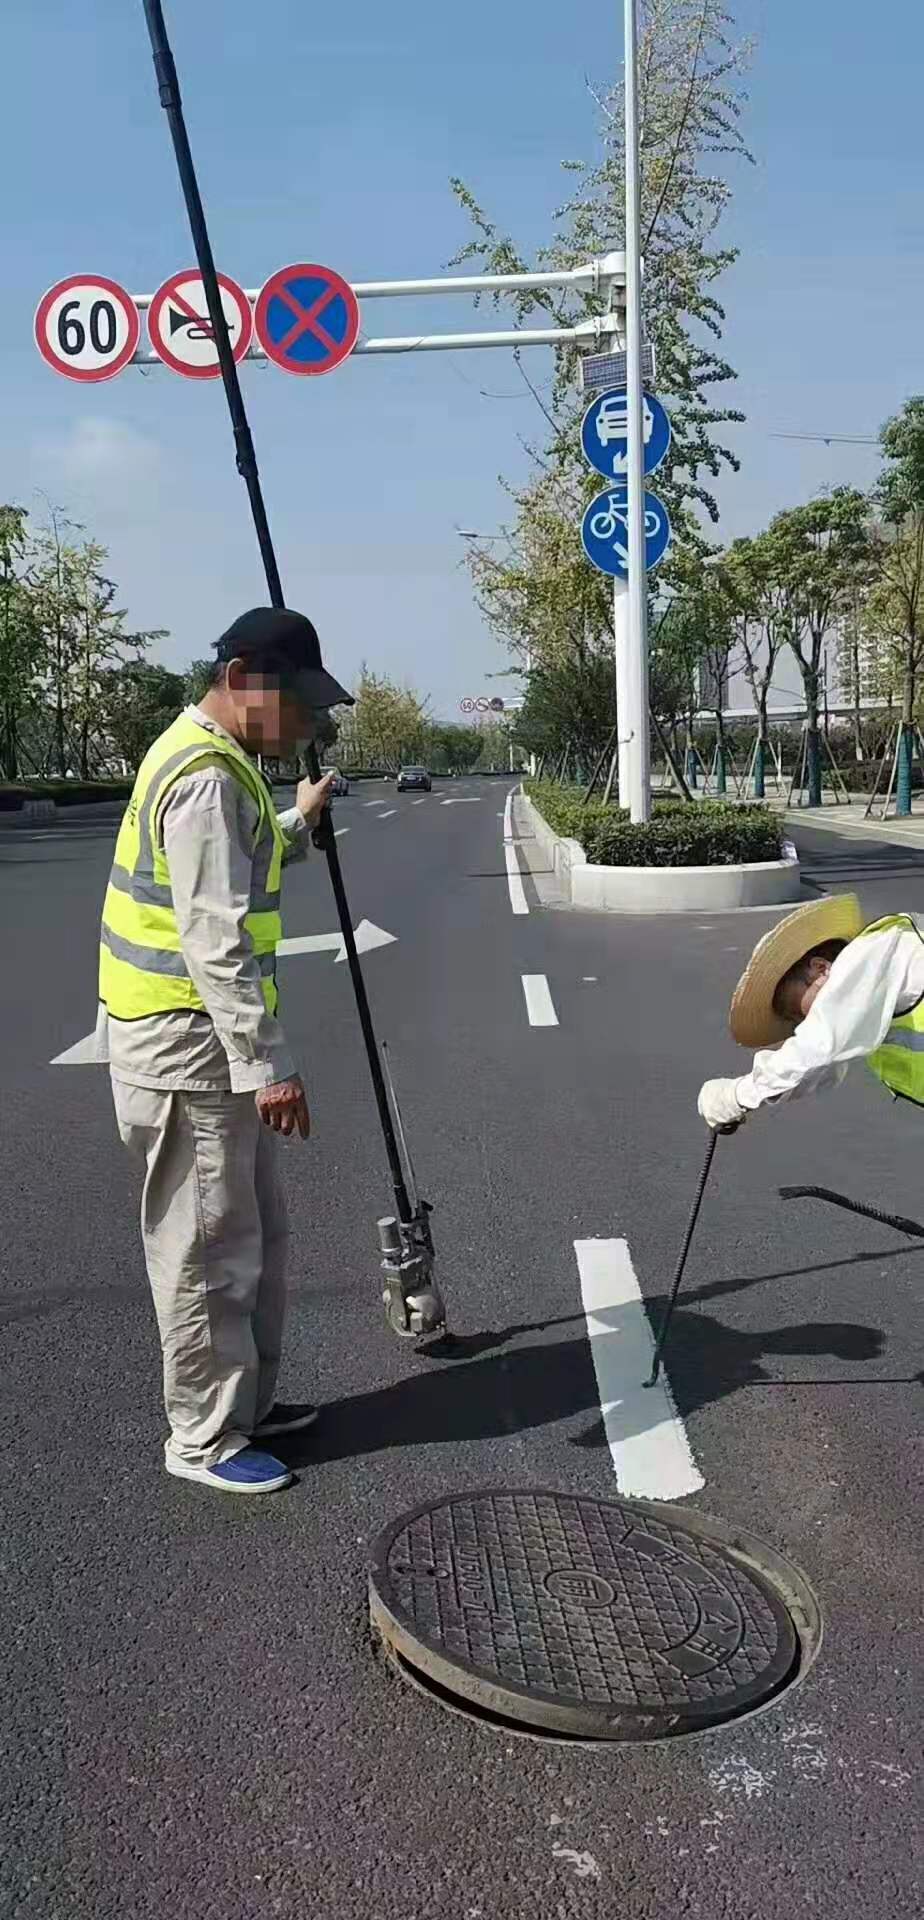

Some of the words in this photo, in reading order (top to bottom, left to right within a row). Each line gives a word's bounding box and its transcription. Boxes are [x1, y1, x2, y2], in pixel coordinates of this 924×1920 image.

[57, 300, 117, 356] 60
[558, 1576, 600, 1600] 雨
[654, 1548, 738, 1663] 市政公用
